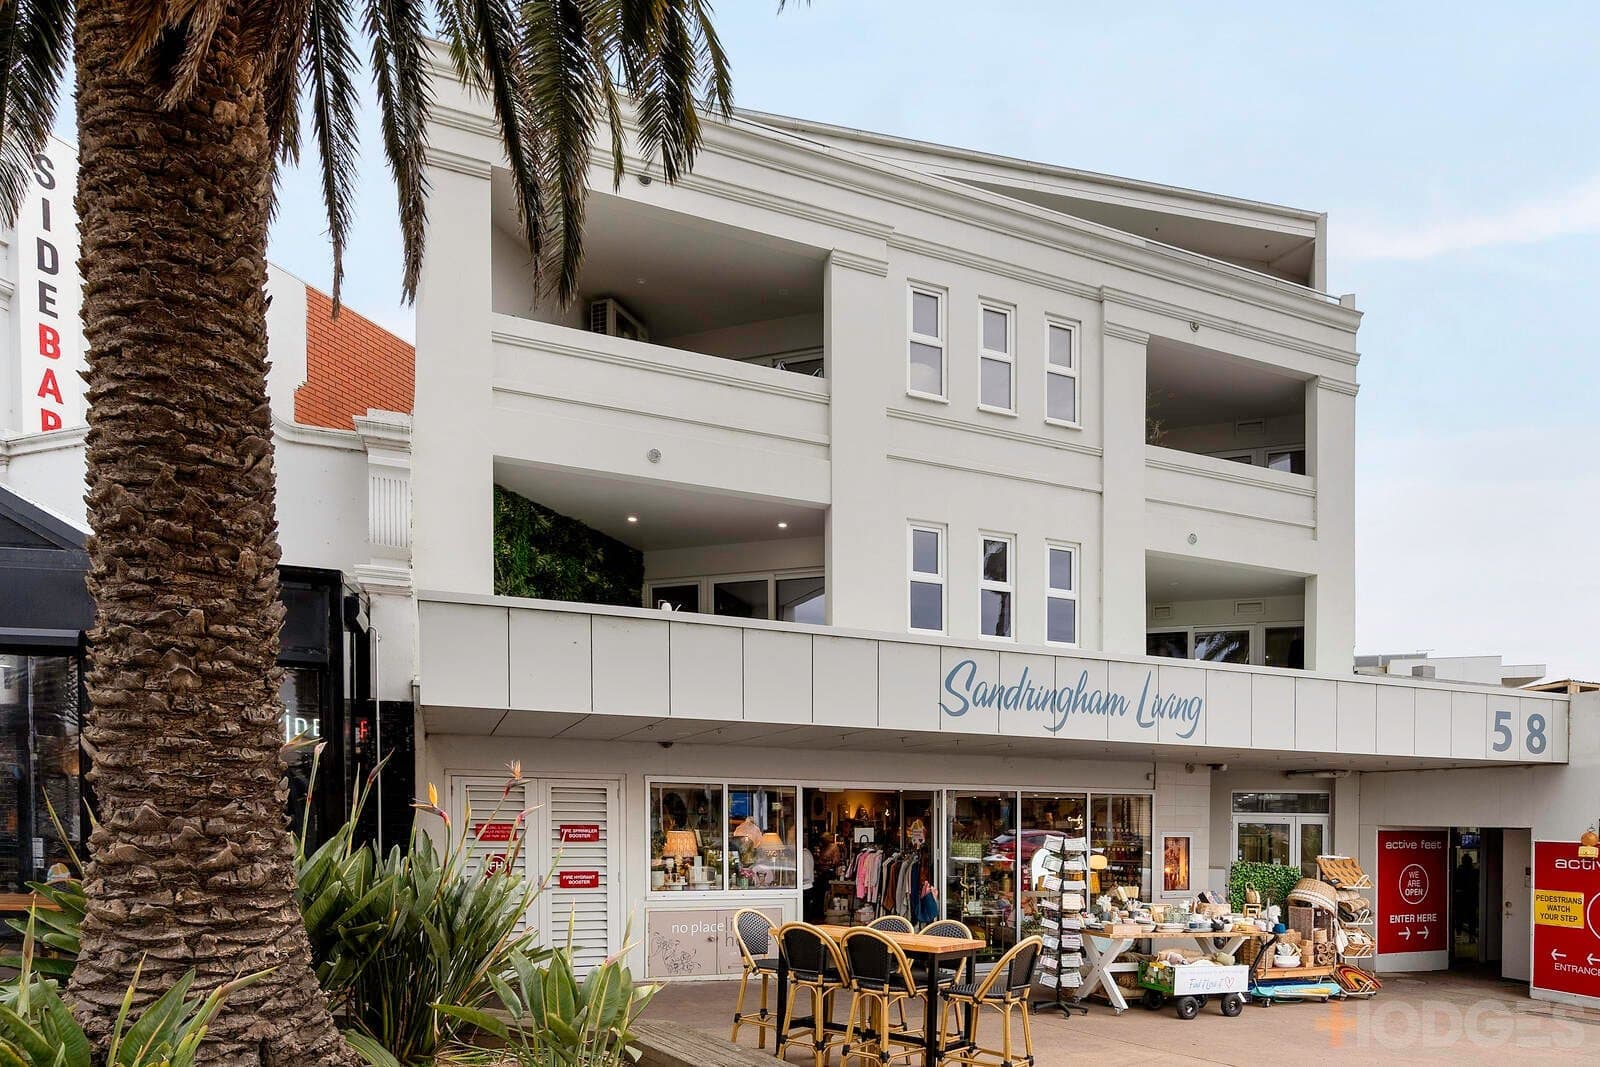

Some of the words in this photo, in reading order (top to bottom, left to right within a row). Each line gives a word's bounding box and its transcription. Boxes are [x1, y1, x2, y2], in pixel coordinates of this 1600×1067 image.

[938, 659, 1130, 732] Sandringham
[1136, 670, 1202, 738] Living
[1385, 840, 1417, 849] active
[1421, 840, 1442, 849] feet
[1555, 859, 1600, 870] acti
[1408, 871, 1420, 879] WE
[1404, 888, 1424, 896] OPEN
[1536, 894, 1583, 905] PEDESTRIANS
[1546, 905, 1571, 913] WATCH
[1389, 914, 1415, 923] ENTER
[1416, 913, 1437, 922] HERE
[1540, 912, 1559, 921] YOUR
[1560, 914, 1578, 922] STEP
[671, 923, 688, 933] no
[691, 921, 725, 936] place
